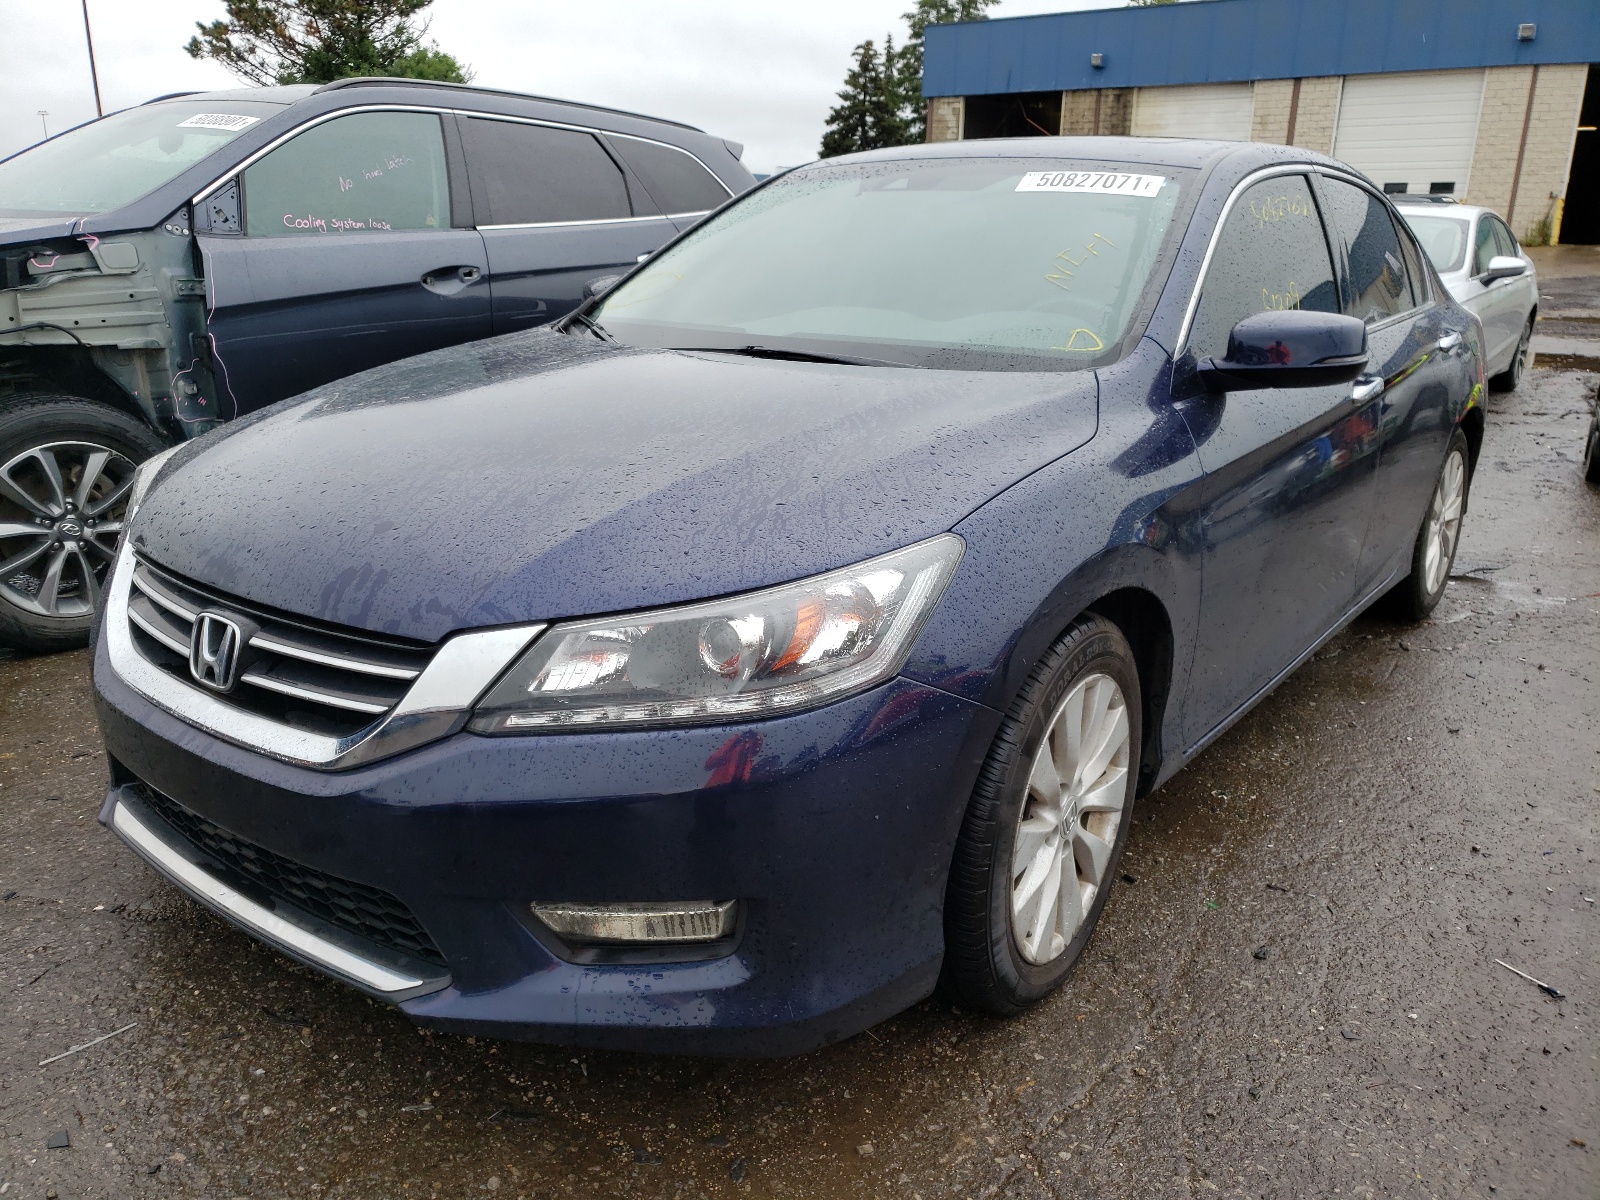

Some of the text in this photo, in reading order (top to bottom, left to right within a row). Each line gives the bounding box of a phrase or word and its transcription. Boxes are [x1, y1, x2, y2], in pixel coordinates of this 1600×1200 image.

[338, 175, 353, 193] No
[1036, 172, 1143, 191] 50827071
[283, 213, 392, 233] Cooling system loose
